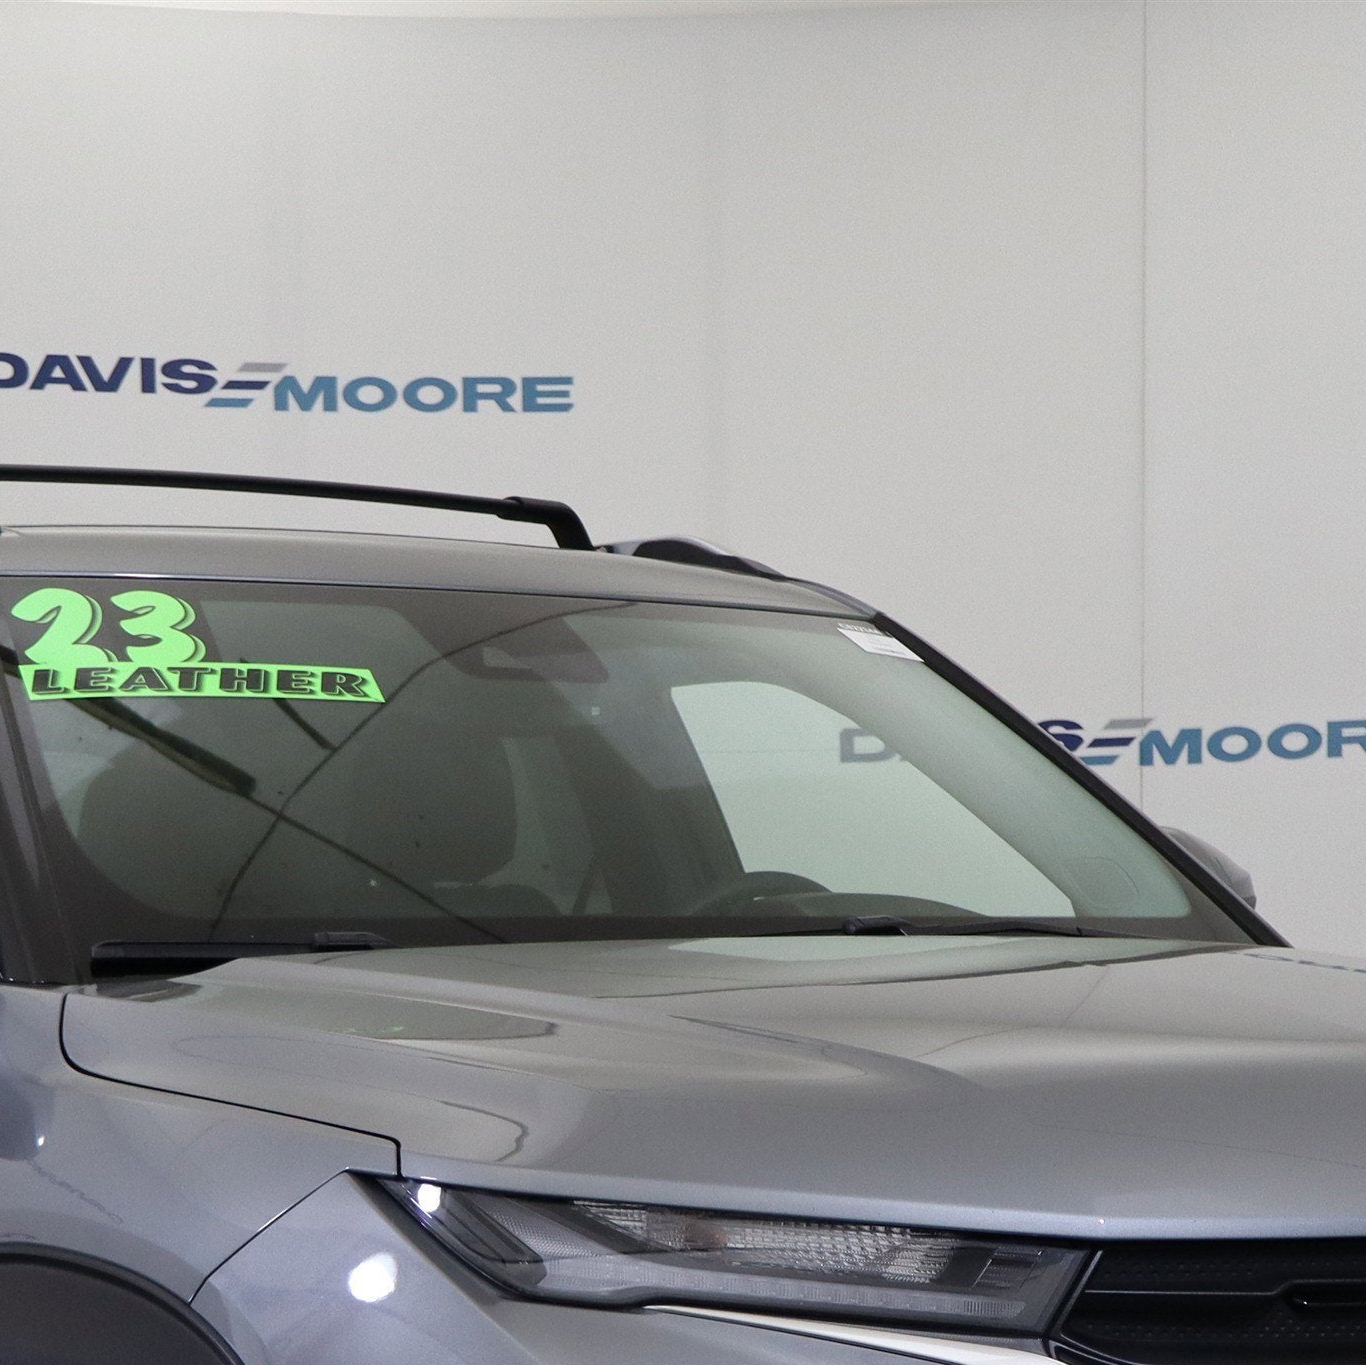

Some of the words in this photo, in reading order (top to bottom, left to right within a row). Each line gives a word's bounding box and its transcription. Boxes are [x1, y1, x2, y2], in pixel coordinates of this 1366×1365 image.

[274, 375, 573, 413] MOORE
[11, 587, 207, 665] 23
[33, 666, 369, 697] LEATHER
